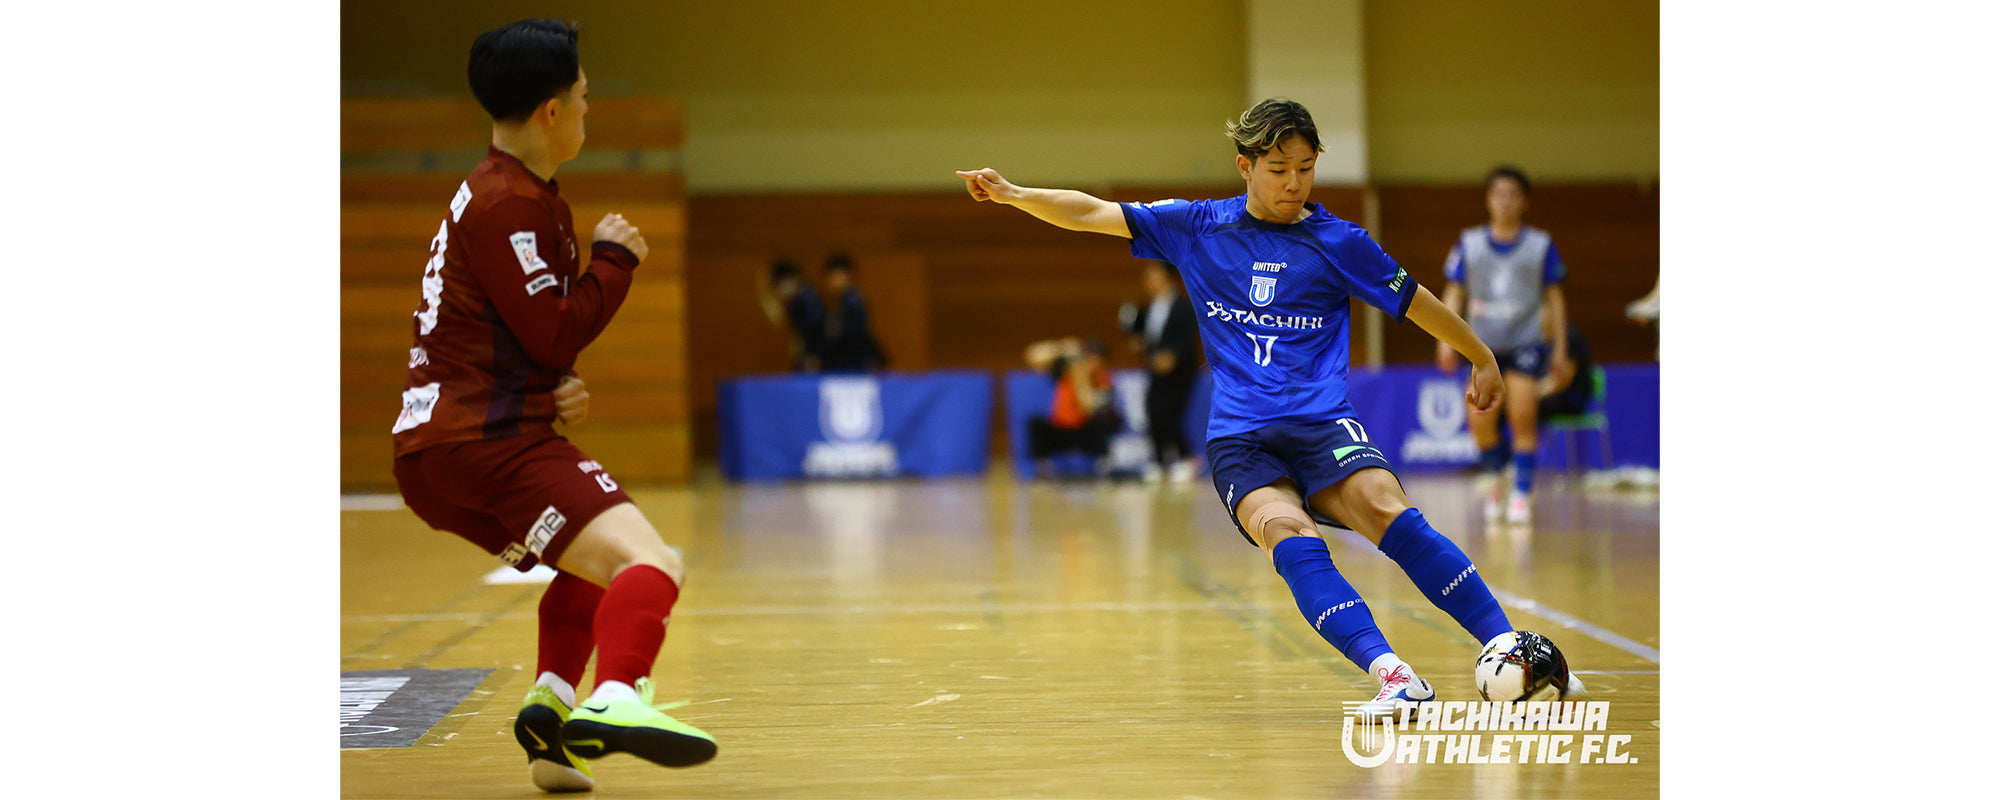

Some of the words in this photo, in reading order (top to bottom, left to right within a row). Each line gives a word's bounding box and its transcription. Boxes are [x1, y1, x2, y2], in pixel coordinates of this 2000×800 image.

[1245, 332, 1279, 367] 17
[1335, 417, 1369, 443] 17
[1315, 600, 1355, 631] UNITED
